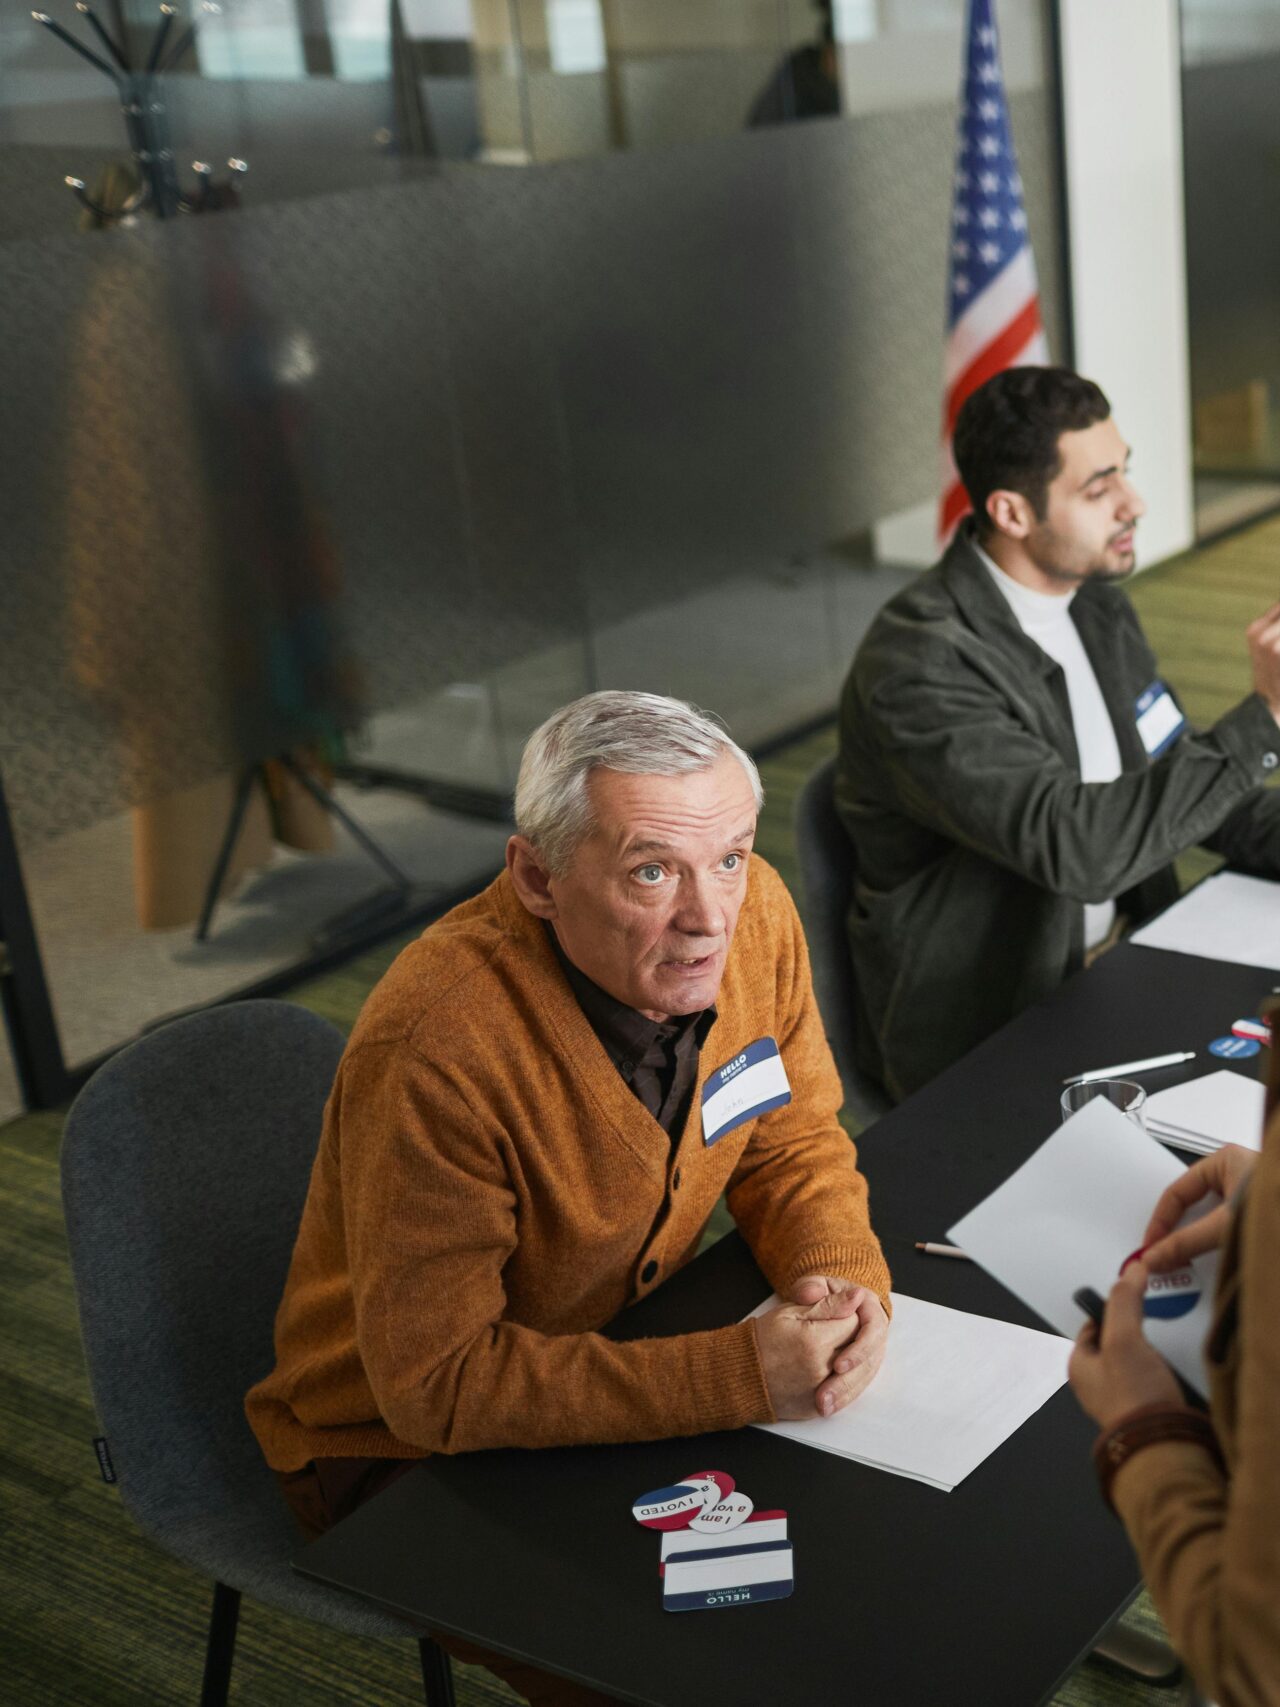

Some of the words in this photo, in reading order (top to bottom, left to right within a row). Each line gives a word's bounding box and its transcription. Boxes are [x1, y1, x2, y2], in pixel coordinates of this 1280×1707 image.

[720, 1054, 746, 1078] HELLO
[1148, 1273, 1192, 1291] OTED
[640, 1501, 688, 1516] VOTED
[712, 1504, 733, 1512] vot
[700, 1514, 723, 1522] am
[725, 1516, 731, 1524] I
[707, 1592, 749, 1604] HELLO
